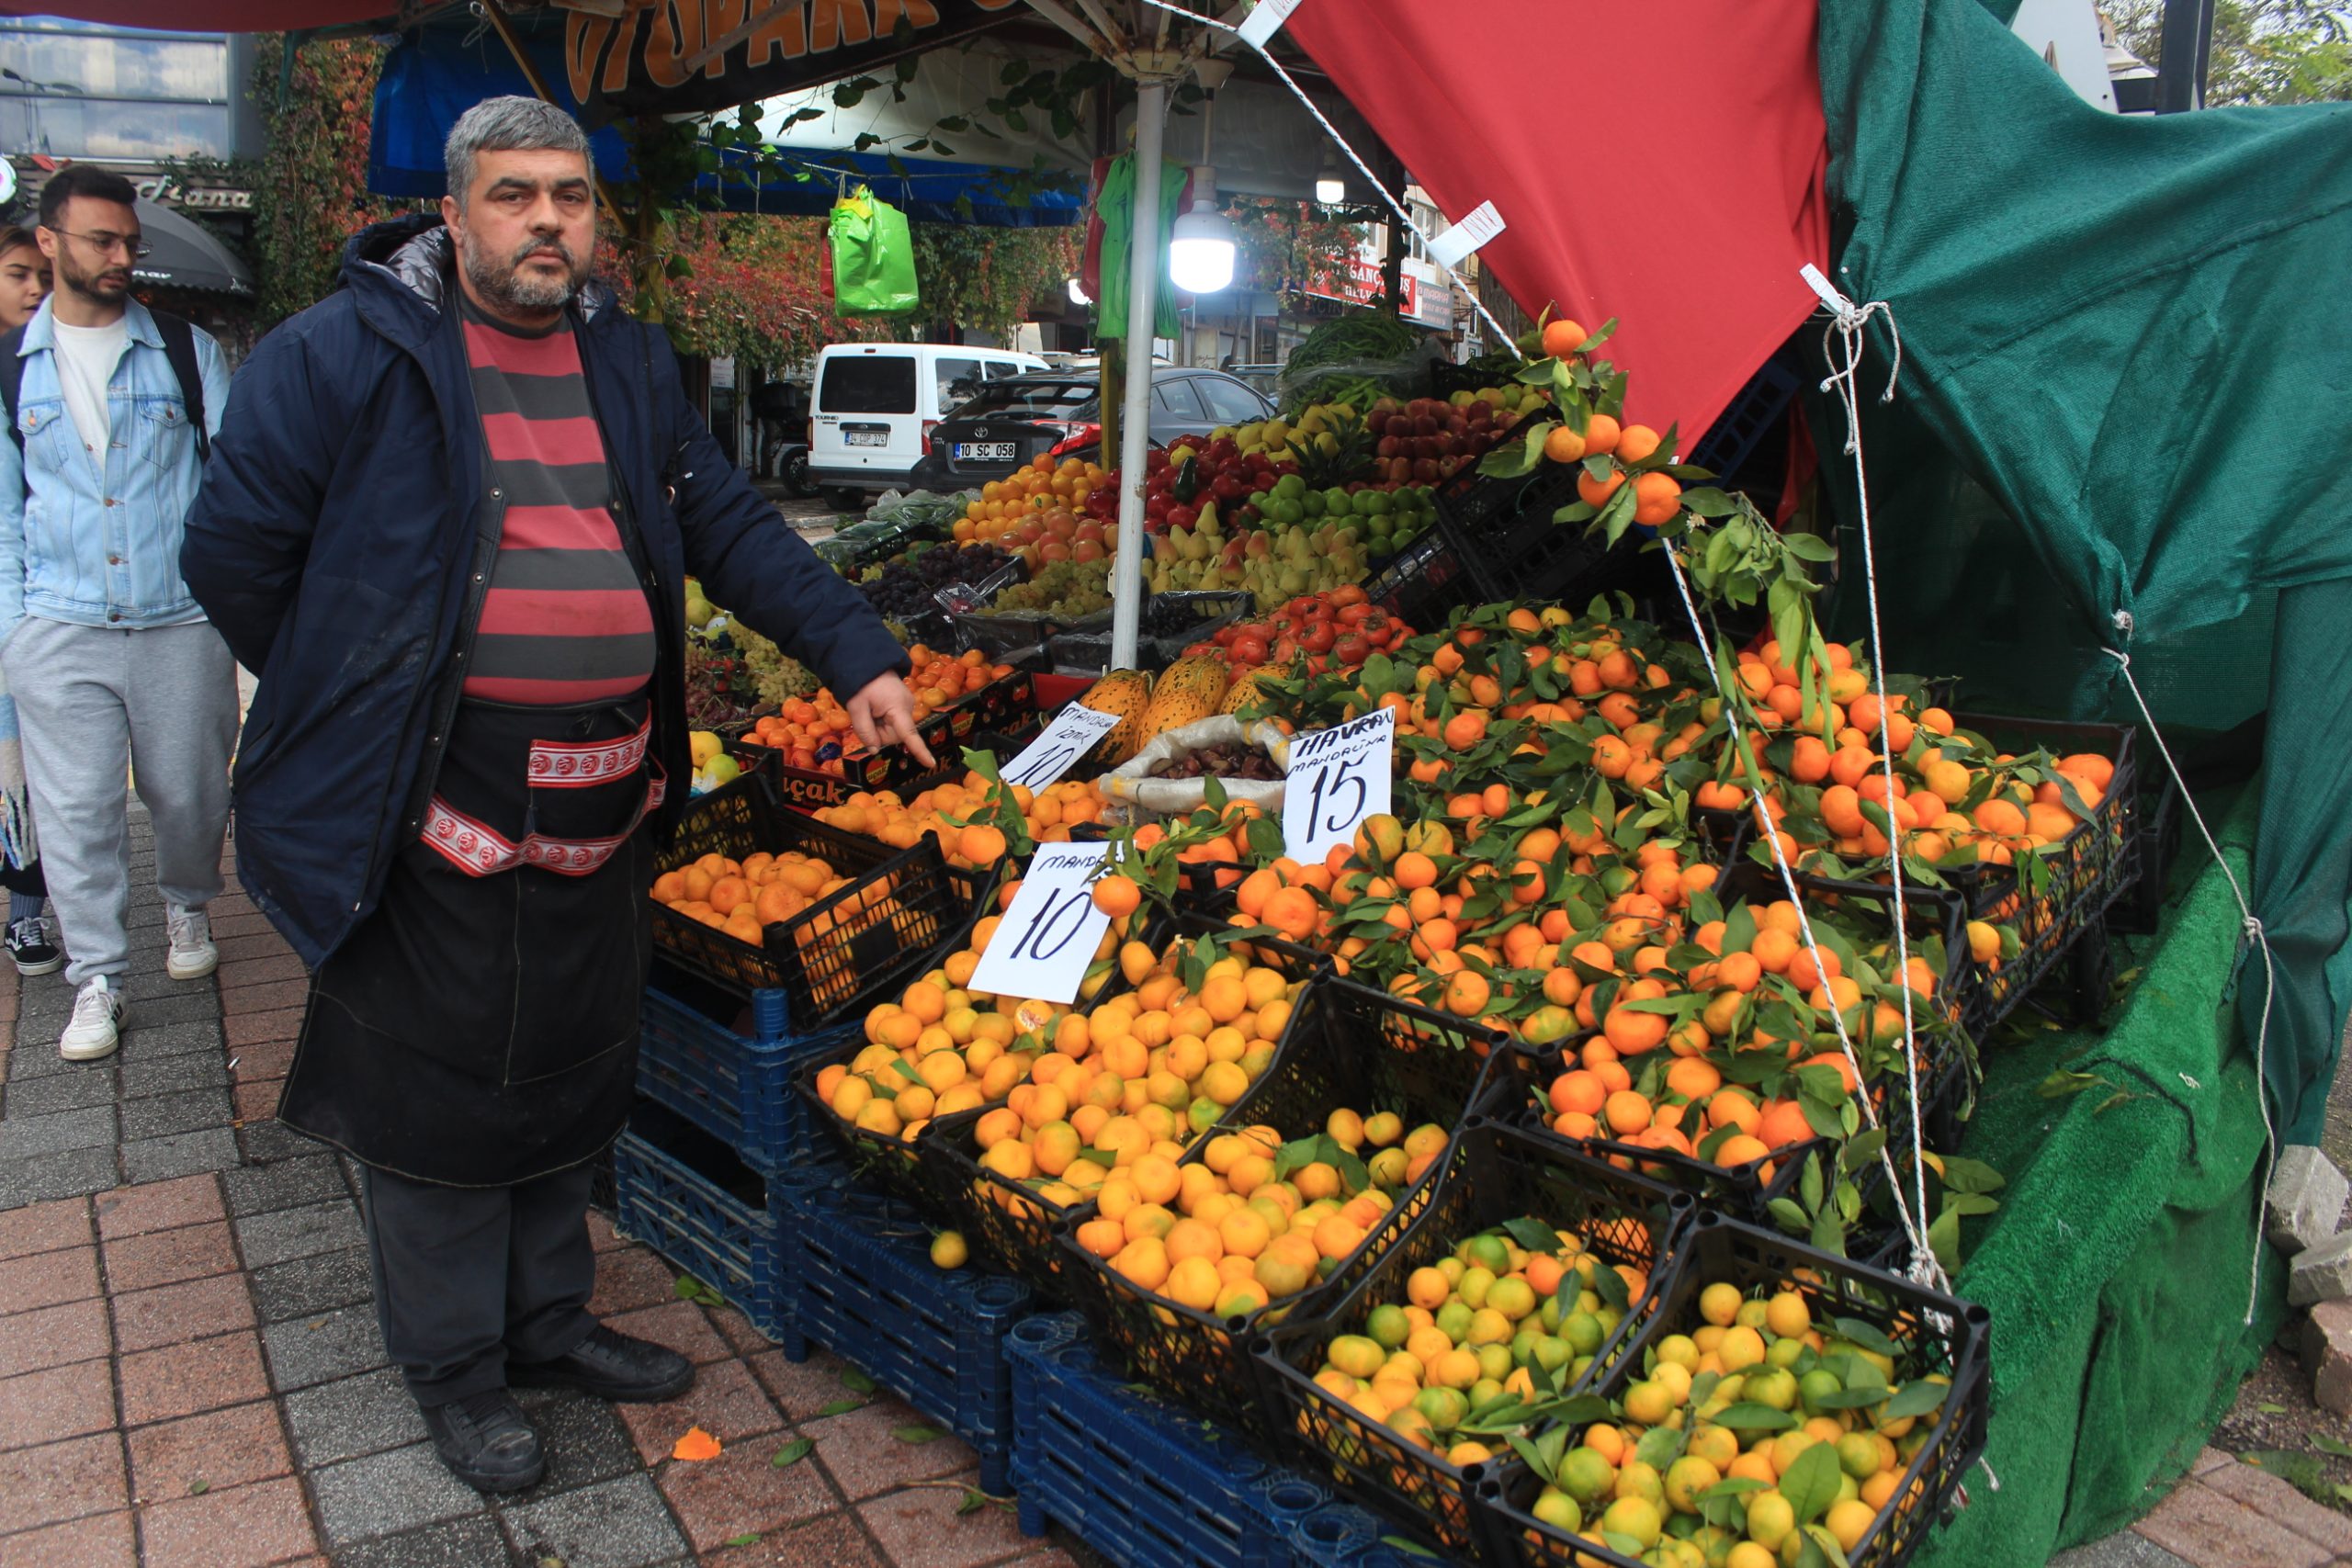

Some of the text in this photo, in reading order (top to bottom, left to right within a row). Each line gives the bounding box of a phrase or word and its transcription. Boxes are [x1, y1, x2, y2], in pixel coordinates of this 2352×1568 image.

[874, 434, 885, 444] 374
[960, 444, 1014, 457] 10 SC 058
[1009, 743, 1075, 789] 10
[1306, 750, 1369, 844] 15
[1010, 887, 1092, 961] 10
